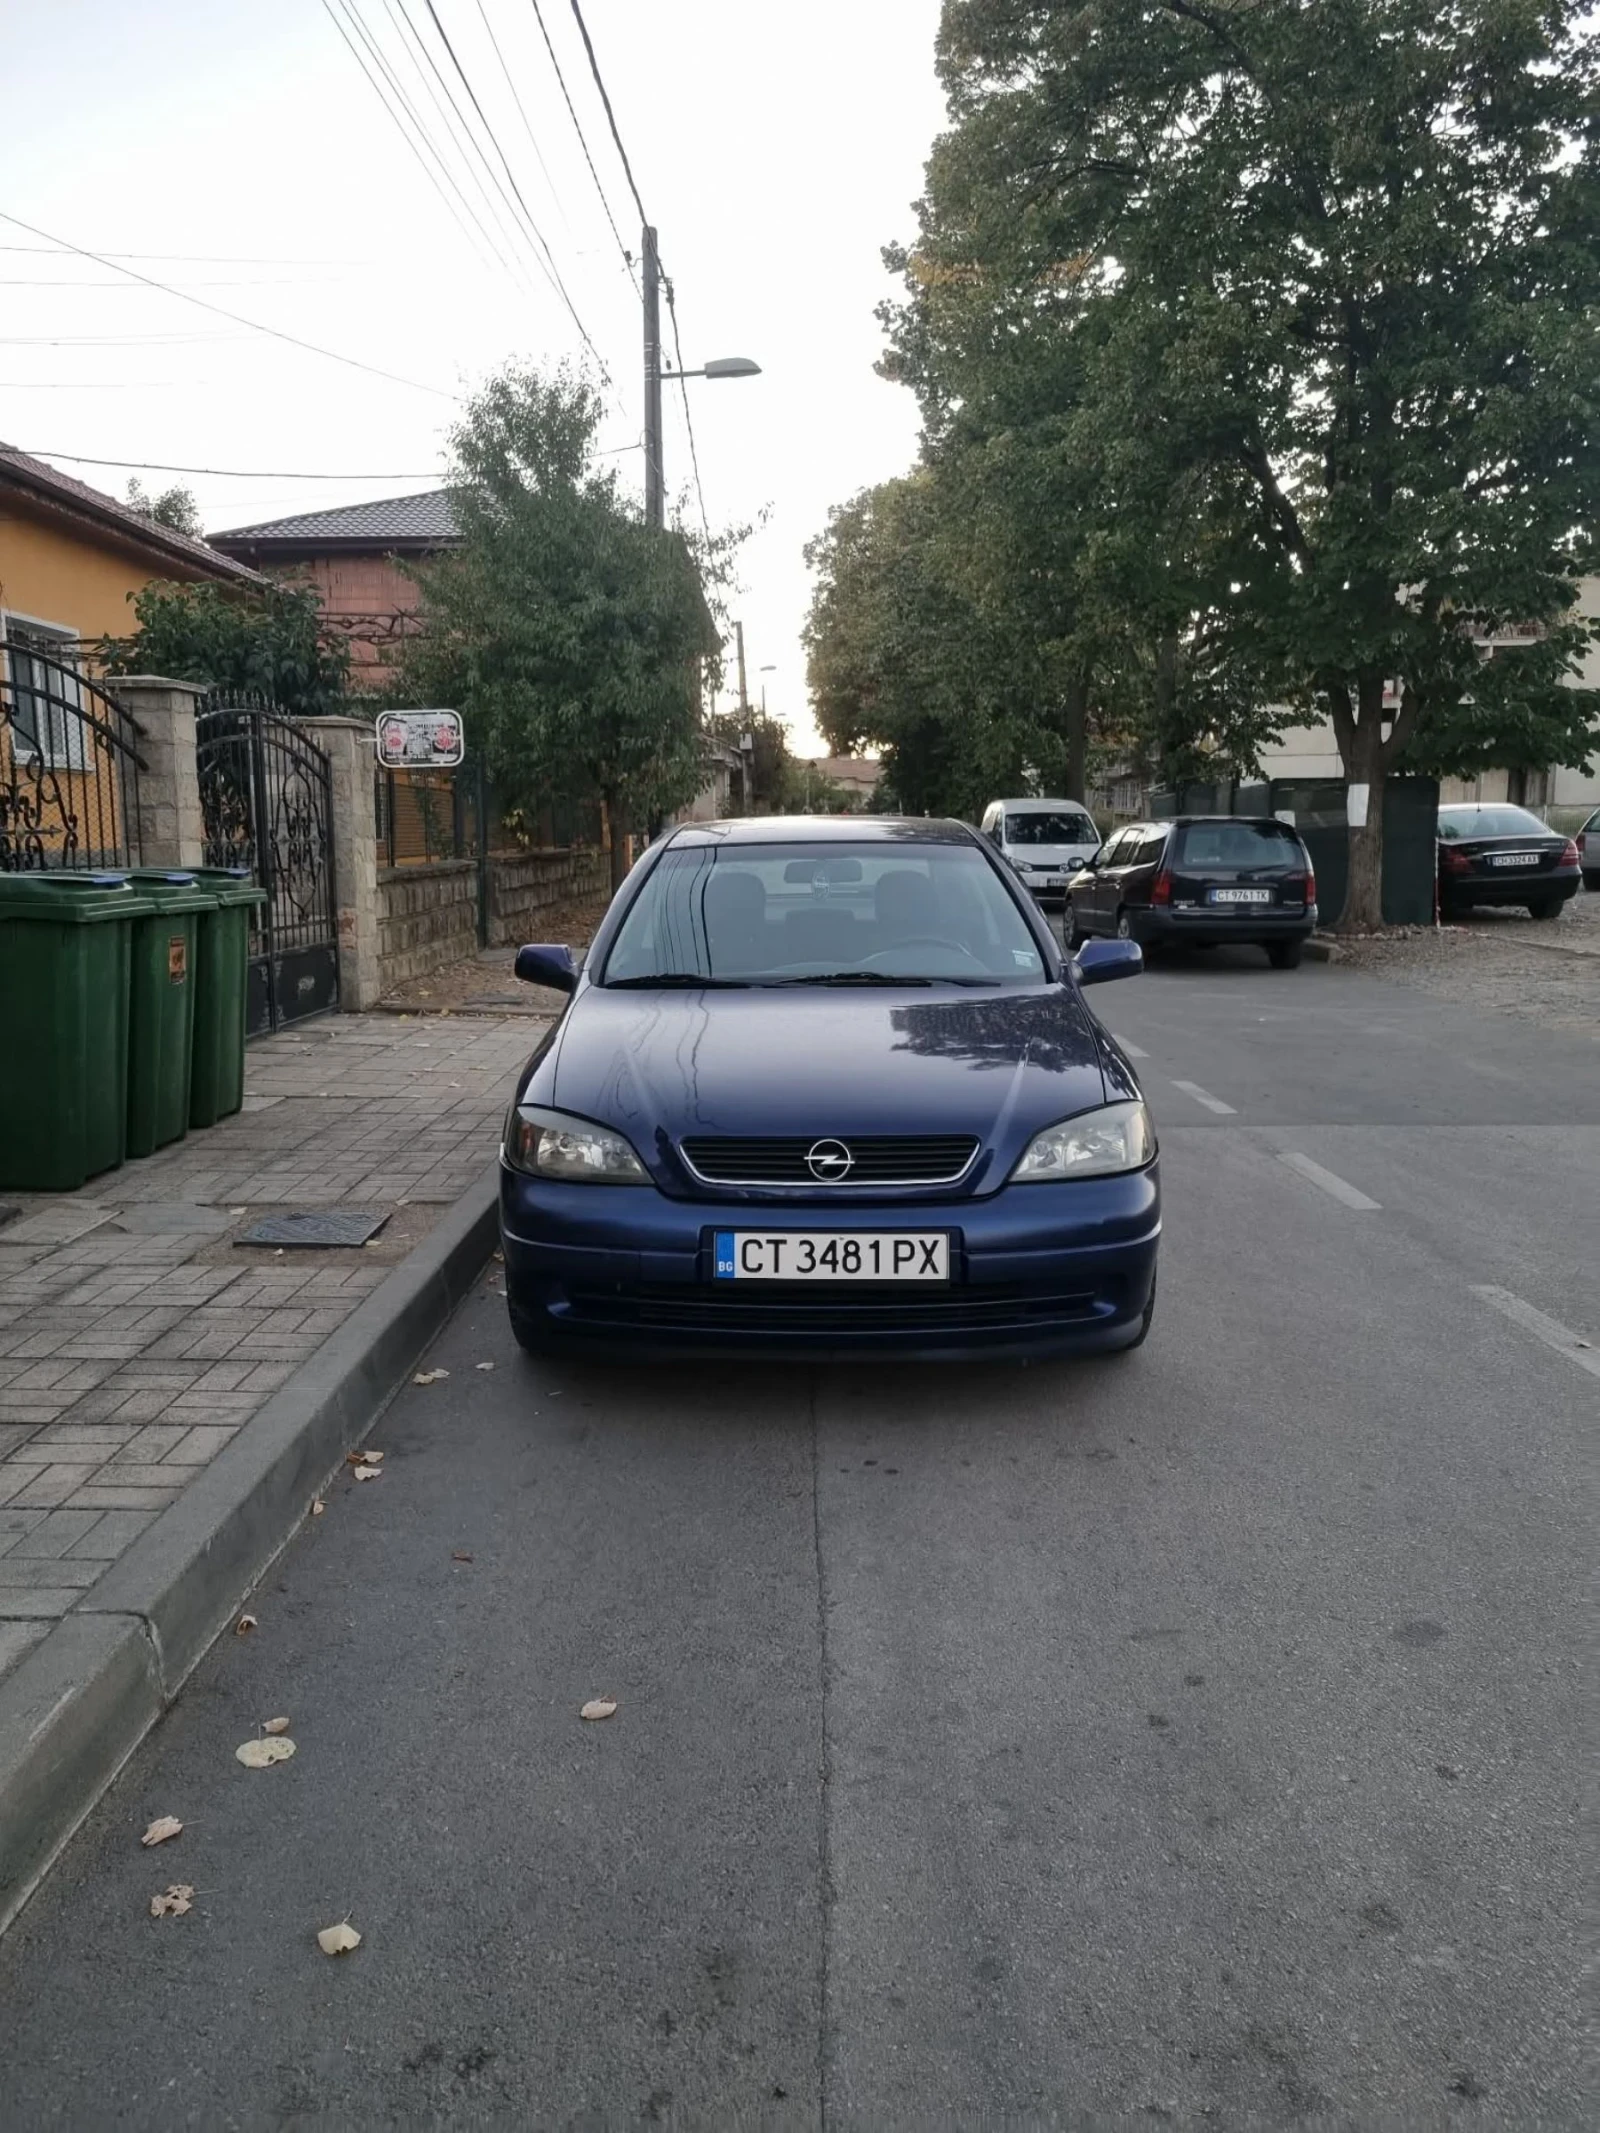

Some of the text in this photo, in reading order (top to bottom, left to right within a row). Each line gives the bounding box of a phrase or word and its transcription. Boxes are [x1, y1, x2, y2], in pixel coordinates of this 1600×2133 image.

[1217, 891, 1267, 901] CT 9761 TK
[741, 1239, 940, 1274] CT 3481 PX
[718, 1261, 733, 1272] BG
